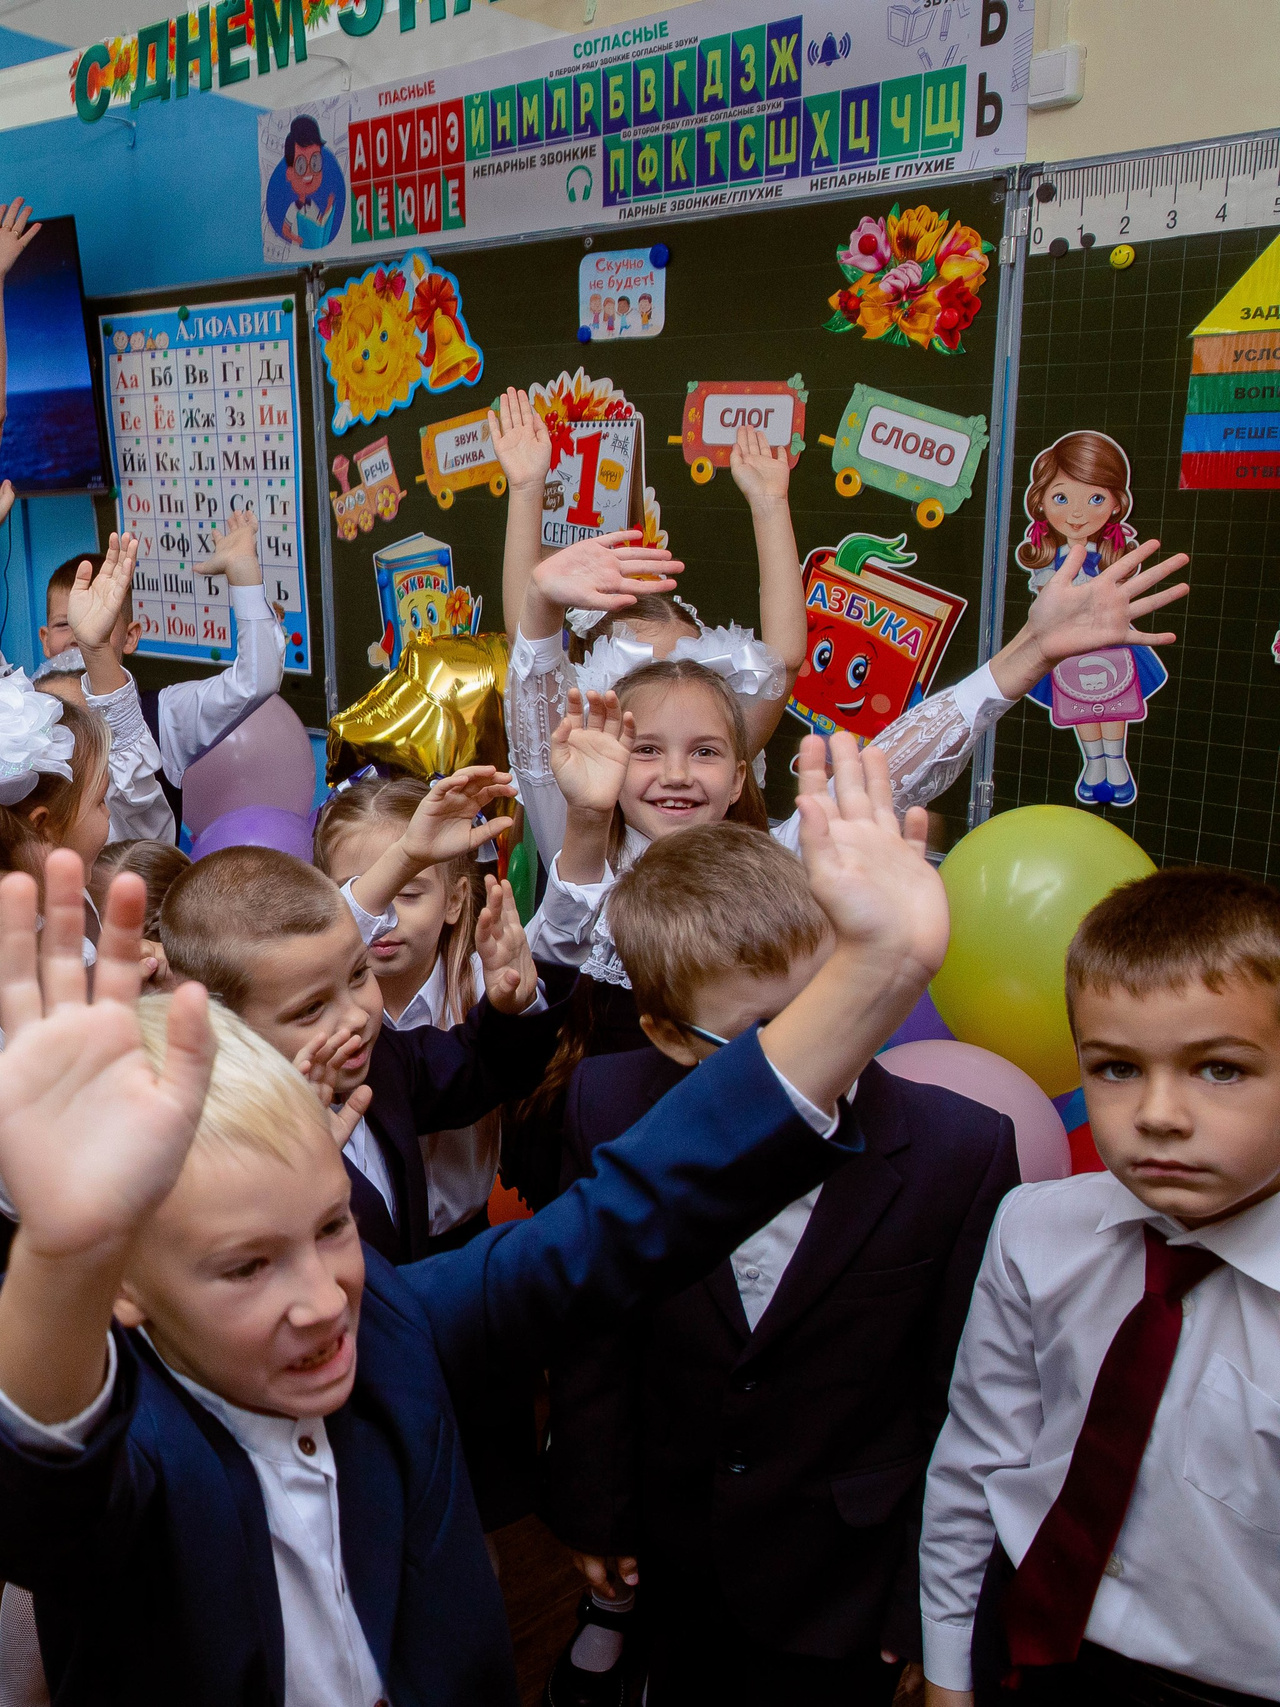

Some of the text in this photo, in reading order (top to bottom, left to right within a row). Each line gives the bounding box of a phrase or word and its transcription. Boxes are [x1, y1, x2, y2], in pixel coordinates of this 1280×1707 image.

[573, 20, 669, 59] СОГЛАСНЫЕ
[555, 64, 581, 77] ПЕРВОМ
[582, 60, 599, 73] РЯДУ
[600, 52, 630, 66] ЗВОНКИЕ
[631, 42, 673, 58] СОГЛАСНЫЕ
[674, 36, 699, 48] ЗВУКИ
[75, 44, 111, 122] С
[378, 80, 436, 107] ГЛАСНЫЕ
[633, 125, 660, 137] ВТОРОМ
[662, 121, 680, 133] РЯДУ
[681, 116, 709, 129] ГЛУХИЕ
[710, 106, 754, 121] СОГЛАСНЫЕ
[756, 101, 782, 113] ЗВУКИ
[472, 144, 597, 180] НЕПАРНЫЕ ЗВОНКИЕ
[810, 157, 956, 192] НЕПАРНЫЕ ГЛУХИЕ
[619, 184, 783, 220] ПАРНЫЕ ЗВОНКИЕ/ГЛУХИЕ
[1033, 227, 1043, 245] 0
[1077, 224, 1084, 242] 1
[1120, 216, 1131, 234] 2
[1166, 210, 1178, 229] 3
[1215, 203, 1228, 222] 4
[595, 257, 644, 275] Скучно
[589, 271, 655, 292] не будет!
[176, 310, 285, 341] АЛФАВИТ
[116, 358, 285, 391] Аа Бб Вв Гг Дд
[1234, 386, 1280, 400] ВОП
[120, 404, 289, 431] Ее Ёё Жж Зз Ии
[719, 407, 775, 429] СЛОГ
[454, 430, 479, 447] ЗВУК
[871, 422, 956, 467] СЛОВО
[121, 448, 291, 472] Йй Кк Лл Мм Нн
[364, 458, 390, 482] РЕЧЬ
[454, 449, 486, 467] БУКВА
[566, 430, 602, 528] 1
[127, 493, 151, 514] Оо
[159, 493, 185, 513] Пп
[194, 491, 218, 518] Рр
[265, 494, 290, 515] Тт
[160, 532, 190, 558] Фф
[197, 533, 217, 553] Х
[267, 536, 292, 558] Чч
[163, 573, 193, 598] Щщ
[204, 575, 220, 596] Ъ
[276, 580, 289, 601] Ь
[395, 574, 448, 600] БУКВАРЬ
[138, 613, 227, 640] Ээ Юю Яя
[807, 582, 922, 656] АЗБУКА
